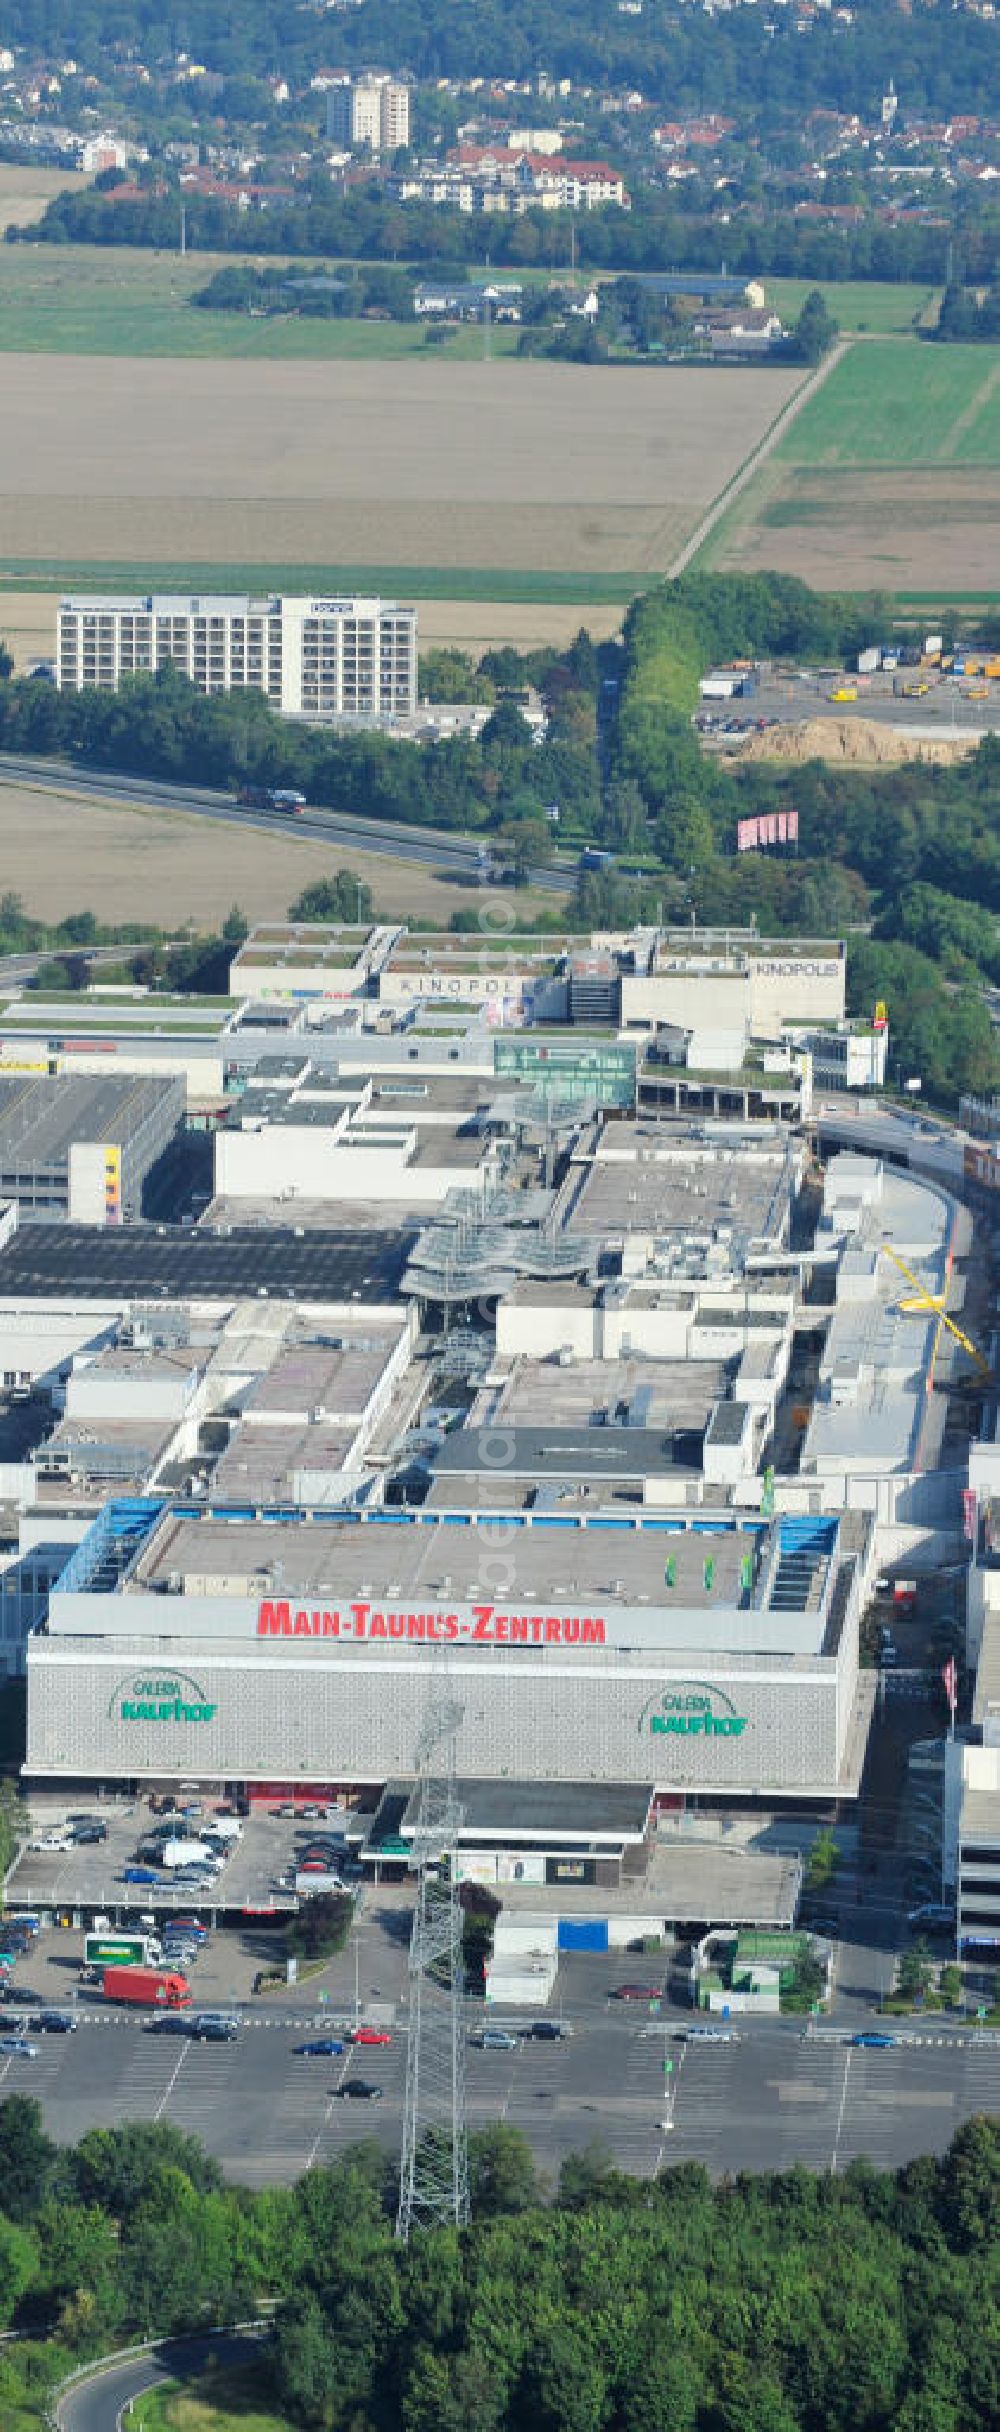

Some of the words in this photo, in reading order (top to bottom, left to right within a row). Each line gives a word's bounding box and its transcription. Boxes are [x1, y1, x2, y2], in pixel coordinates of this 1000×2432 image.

[256, 1600, 606, 1643] MAIN-TAUNUS-ZENTRUM
[134, 1680, 182, 1695] GALERIA
[662, 1694, 711, 1710] GALERIA
